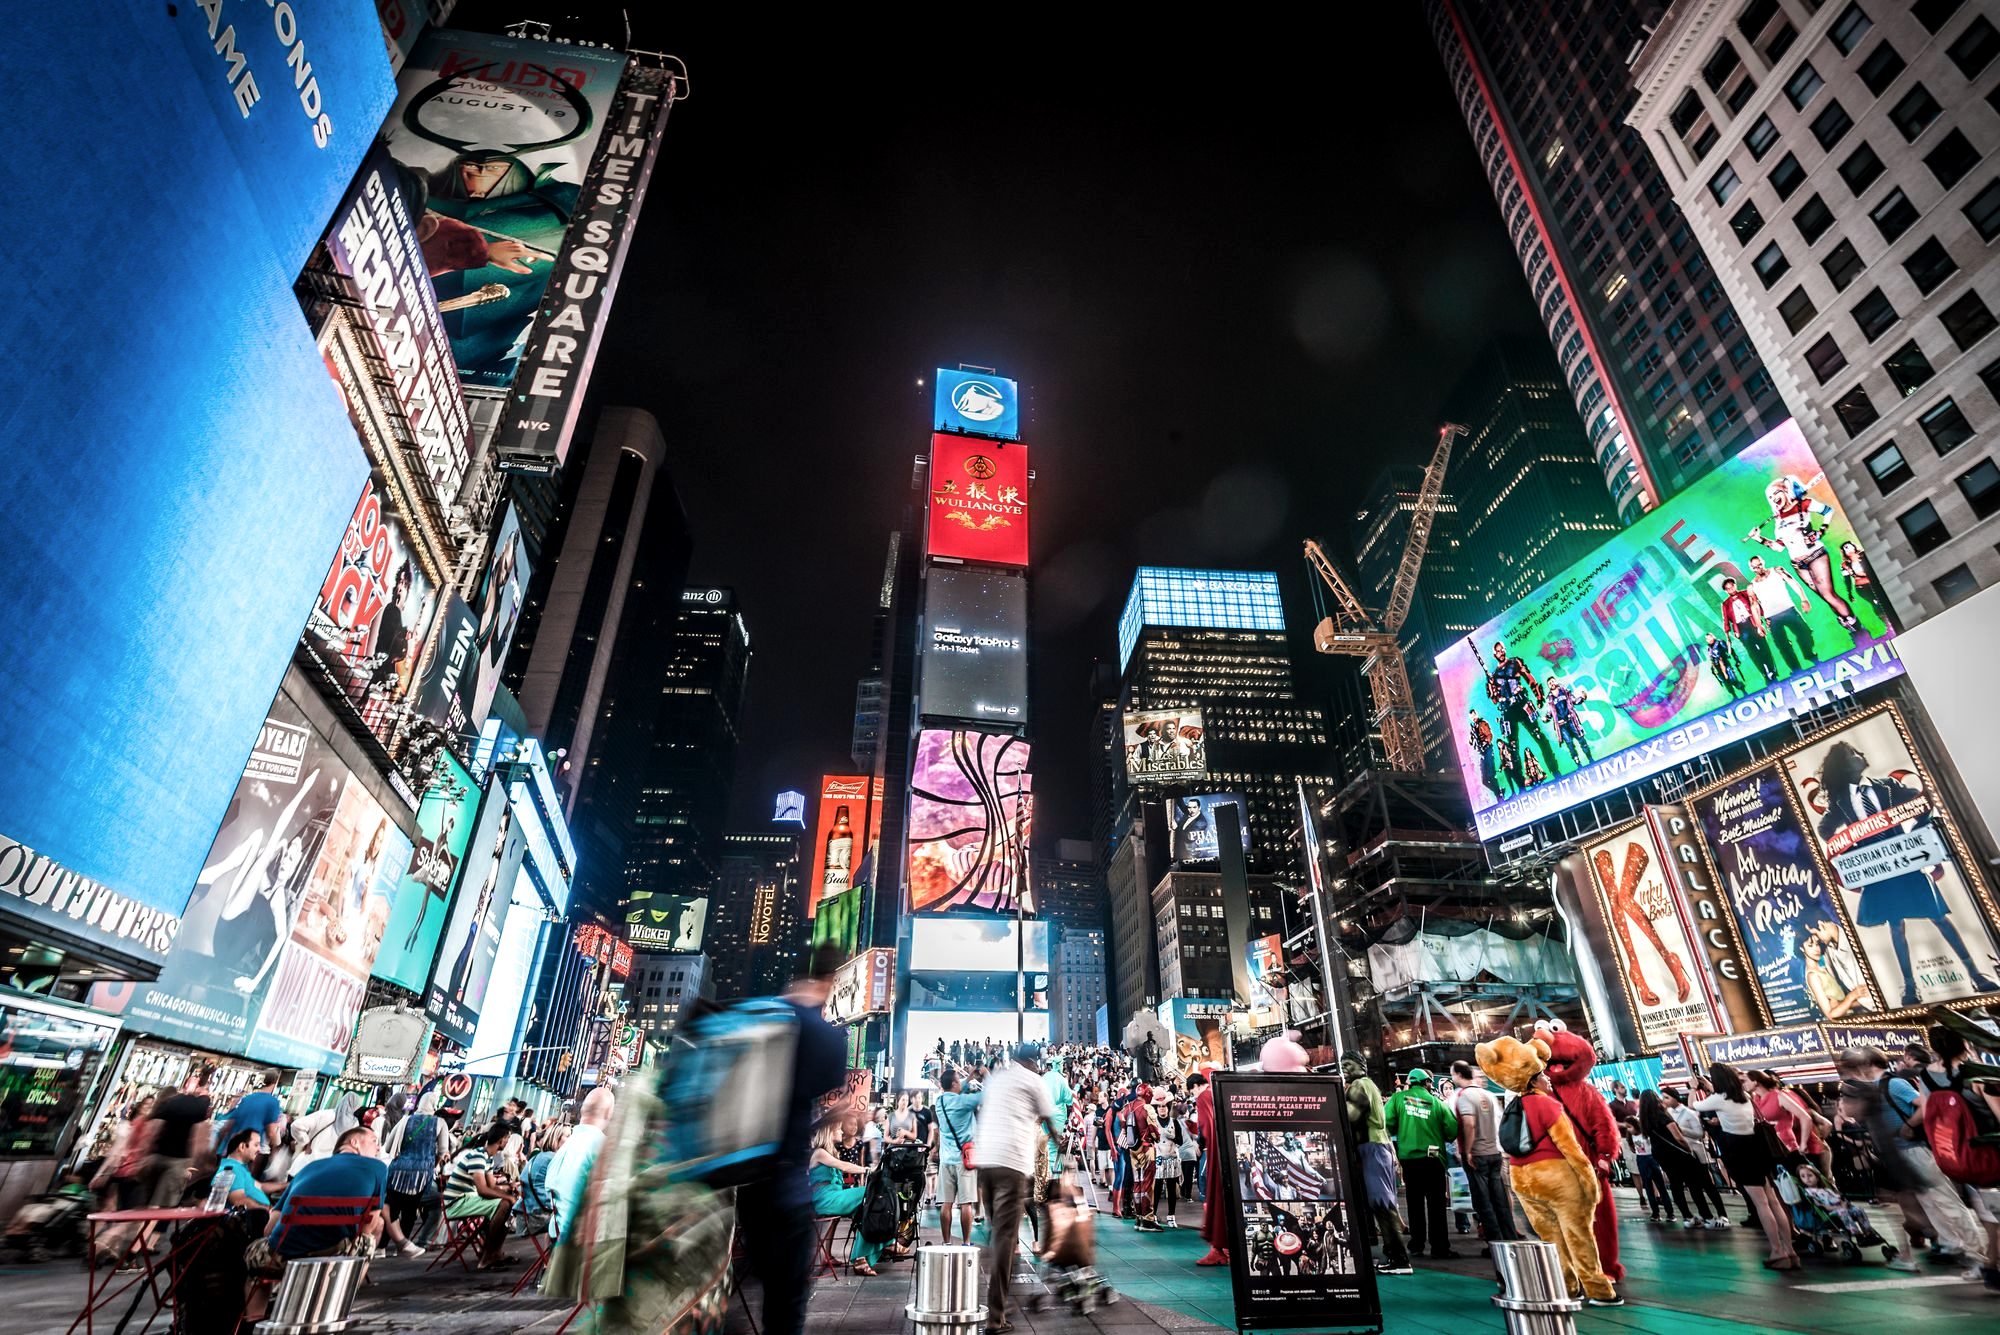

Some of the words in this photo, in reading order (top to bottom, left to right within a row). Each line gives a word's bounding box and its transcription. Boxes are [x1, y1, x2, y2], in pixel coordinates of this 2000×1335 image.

[266, 0, 332, 149] ONDS
[437, 50, 589, 92] KUBO
[460, 81, 499, 93] TWO
[430, 96, 533, 113] AUGUST
[544, 108, 566, 119] 19
[596, 91, 658, 206] TIMES
[337, 195, 374, 265] THE
[391, 187, 408, 231] TONY
[403, 229, 423, 279] AWARD
[365, 169, 406, 277] CYNTHIA
[400, 264, 426, 336] ERIVO
[423, 338, 453, 422] HEATHER
[446, 406, 471, 480] HEADLEY
[530, 220, 613, 398] SQUARE
[517, 420, 551, 431] NYC
[932, 480, 1028, 506] 五粮液
[934, 496, 1023, 515] WULIANGYE
[344, 525, 363, 564] OF
[682, 592, 705, 600] anz
[1207, 579, 1272, 594] BARCLAYS
[1510, 625, 1534, 648] MARGOT
[1559, 589, 1576, 606] JOEL
[1576, 558, 1612, 590] KINNAMAN
[1536, 518, 1716, 679] SUICIDE
[1555, 600, 1575, 617] VIOLA
[1574, 582, 1595, 602] DAVIS
[1504, 627, 1519, 640] WILL
[1518, 611, 1538, 627] SMITH
[1559, 577, 1577, 594] LETO
[933, 632, 973, 646] Galaxy
[973, 635, 1010, 648] TabPro
[1011, 640, 1020, 649] S
[933, 643, 955, 652] 2-in-1
[955, 645, 980, 655] Tablet
[440, 616, 475, 703] NEW
[265, 727, 307, 758] YEARS
[1481, 783, 1558, 830] EXPERIENCE
[1557, 780, 1572, 795] IT
[1574, 770, 1592, 788] IN
[1594, 743, 1665, 783] IMAX
[1667, 721, 1711, 752] 3D
[1713, 686, 1786, 733] NOW
[1790, 639, 1899, 700] PLAYI
[1155, 749, 1174, 760] Les
[829, 783, 861, 791] Budweiser
[1713, 777, 1761, 815] Winner!
[1903, 795, 1929, 812] BEFORE
[1718, 823, 1743, 845] Best
[1742, 806, 1782, 834] Musical!
[1719, 812, 1729, 826] 4
[1727, 808, 1742, 820] TONY
[1741, 799, 1763, 814] AWARDS
[1890, 806, 1926, 825] JANUARY
[1925, 802, 1931, 811] 1
[1828, 833, 1852, 856] FINAL
[1848, 814, 1890, 843] MONTHS
[1838, 850, 1882, 871] PEDESTRIAN
[1881, 841, 1905, 857] FLOW
[1904, 834, 1927, 851] ZONE
[1734, 842, 1761, 881] An
[1843, 870, 1861, 885] KEEP
[1861, 860, 1892, 878] MOVING
[0, 845, 179, 953] OUTFITTERS
[1669, 816, 1739, 980] PALACE
[1730, 862, 1821, 916] American
[757, 884, 776, 943] NOVOTEL
[1649, 900, 1675, 922] Boots
[1755, 892, 1804, 935] Paris
[1920, 969, 1964, 987] Matilda
[145, 989, 247, 1029] CHICAGOTHEMUSICAL.COM
[1186, 1003, 1206, 1014] ICE
[1641, 1010, 1665, 1024] WINNER!
[1664, 1009, 1670, 1020] 6
[1669, 1006, 1685, 1019] TONY
[1644, 1021, 1669, 1031] INCLUDING
[1669, 1018, 1685, 1027] BEST
[1727, 1041, 1769, 1062] American
[1846, 1029, 1886, 1051] American
[363, 1059, 401, 1074] Sanrio
